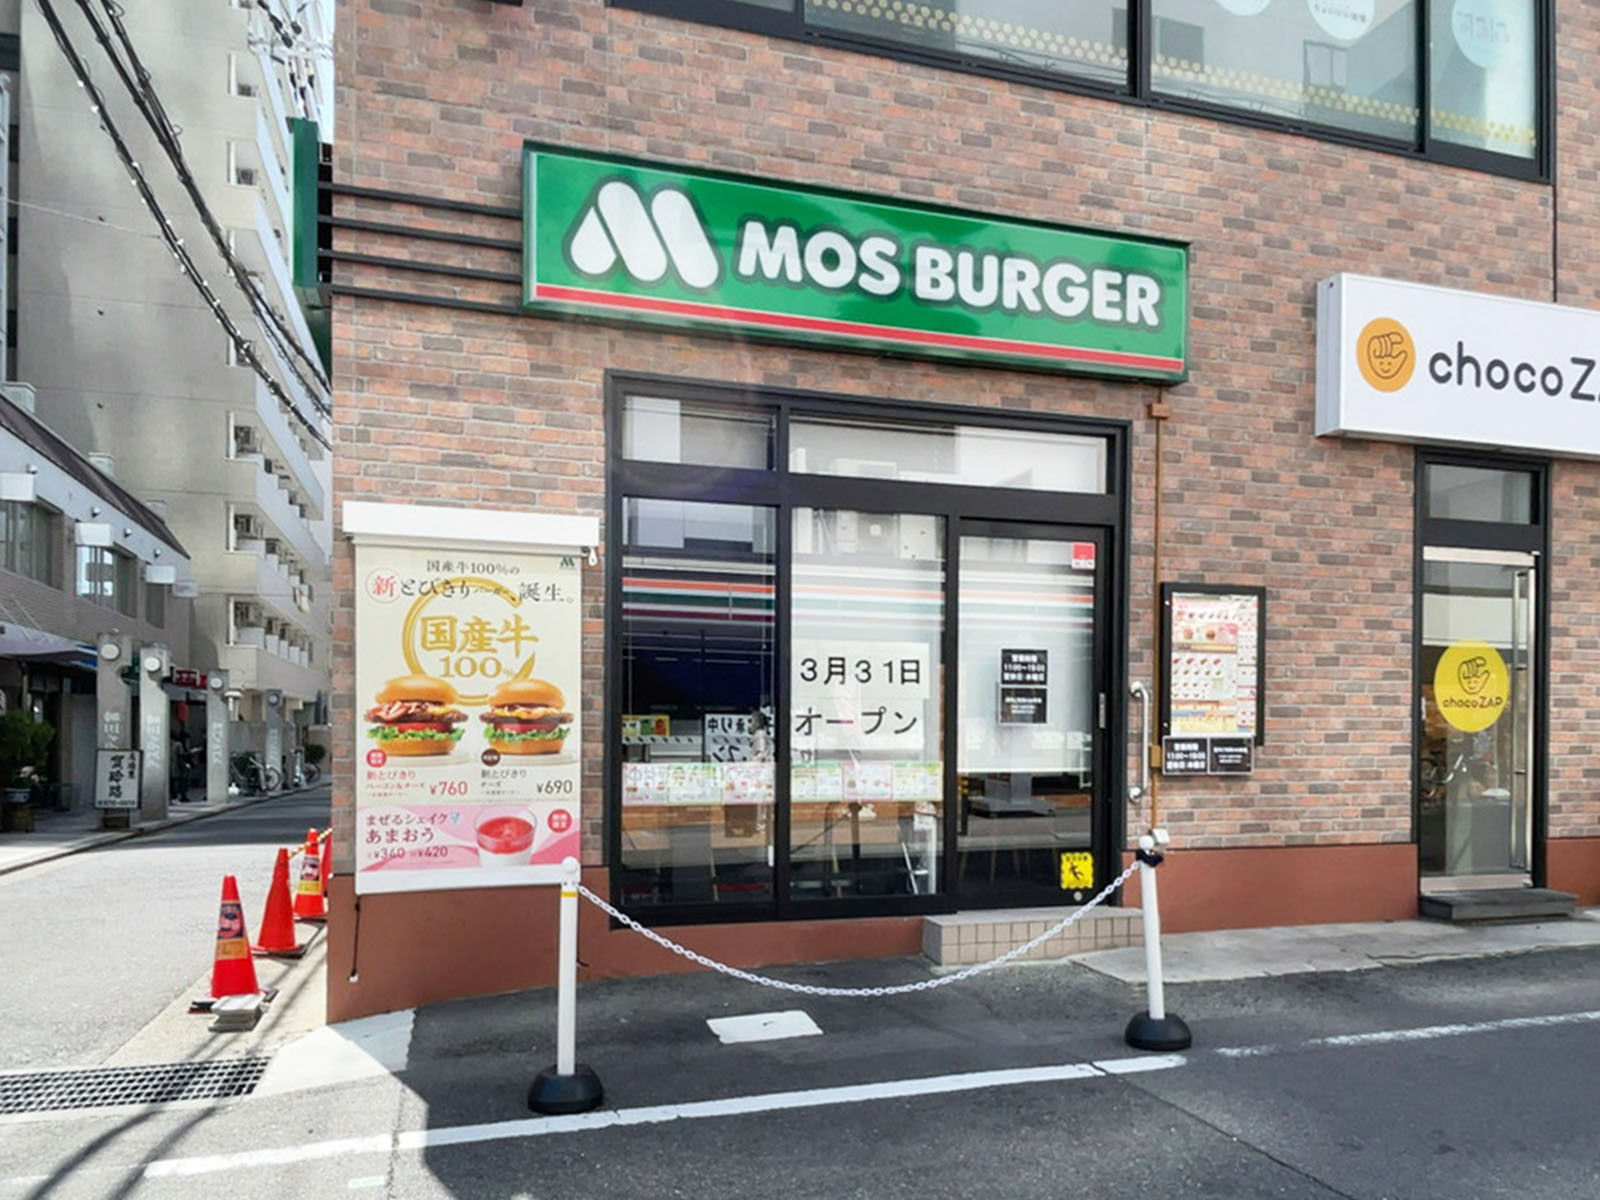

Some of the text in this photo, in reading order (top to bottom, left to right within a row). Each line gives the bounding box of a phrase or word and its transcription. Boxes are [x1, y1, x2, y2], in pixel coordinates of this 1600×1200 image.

[738, 221, 1160, 326] MOS BURGER
[1429, 341, 1600, 402] chocoZ
[420, 613, 539, 659] 国産牛
[800, 656, 921, 685] 3月31日
[1442, 695, 1503, 709] chocoZAP
[795, 705, 918, 736] オープン
[429, 781, 468, 796] ¥760
[537, 780, 573, 794] ¥690
[366, 812, 448, 826] まぜるシェイク
[366, 827, 434, 844] あまおう
